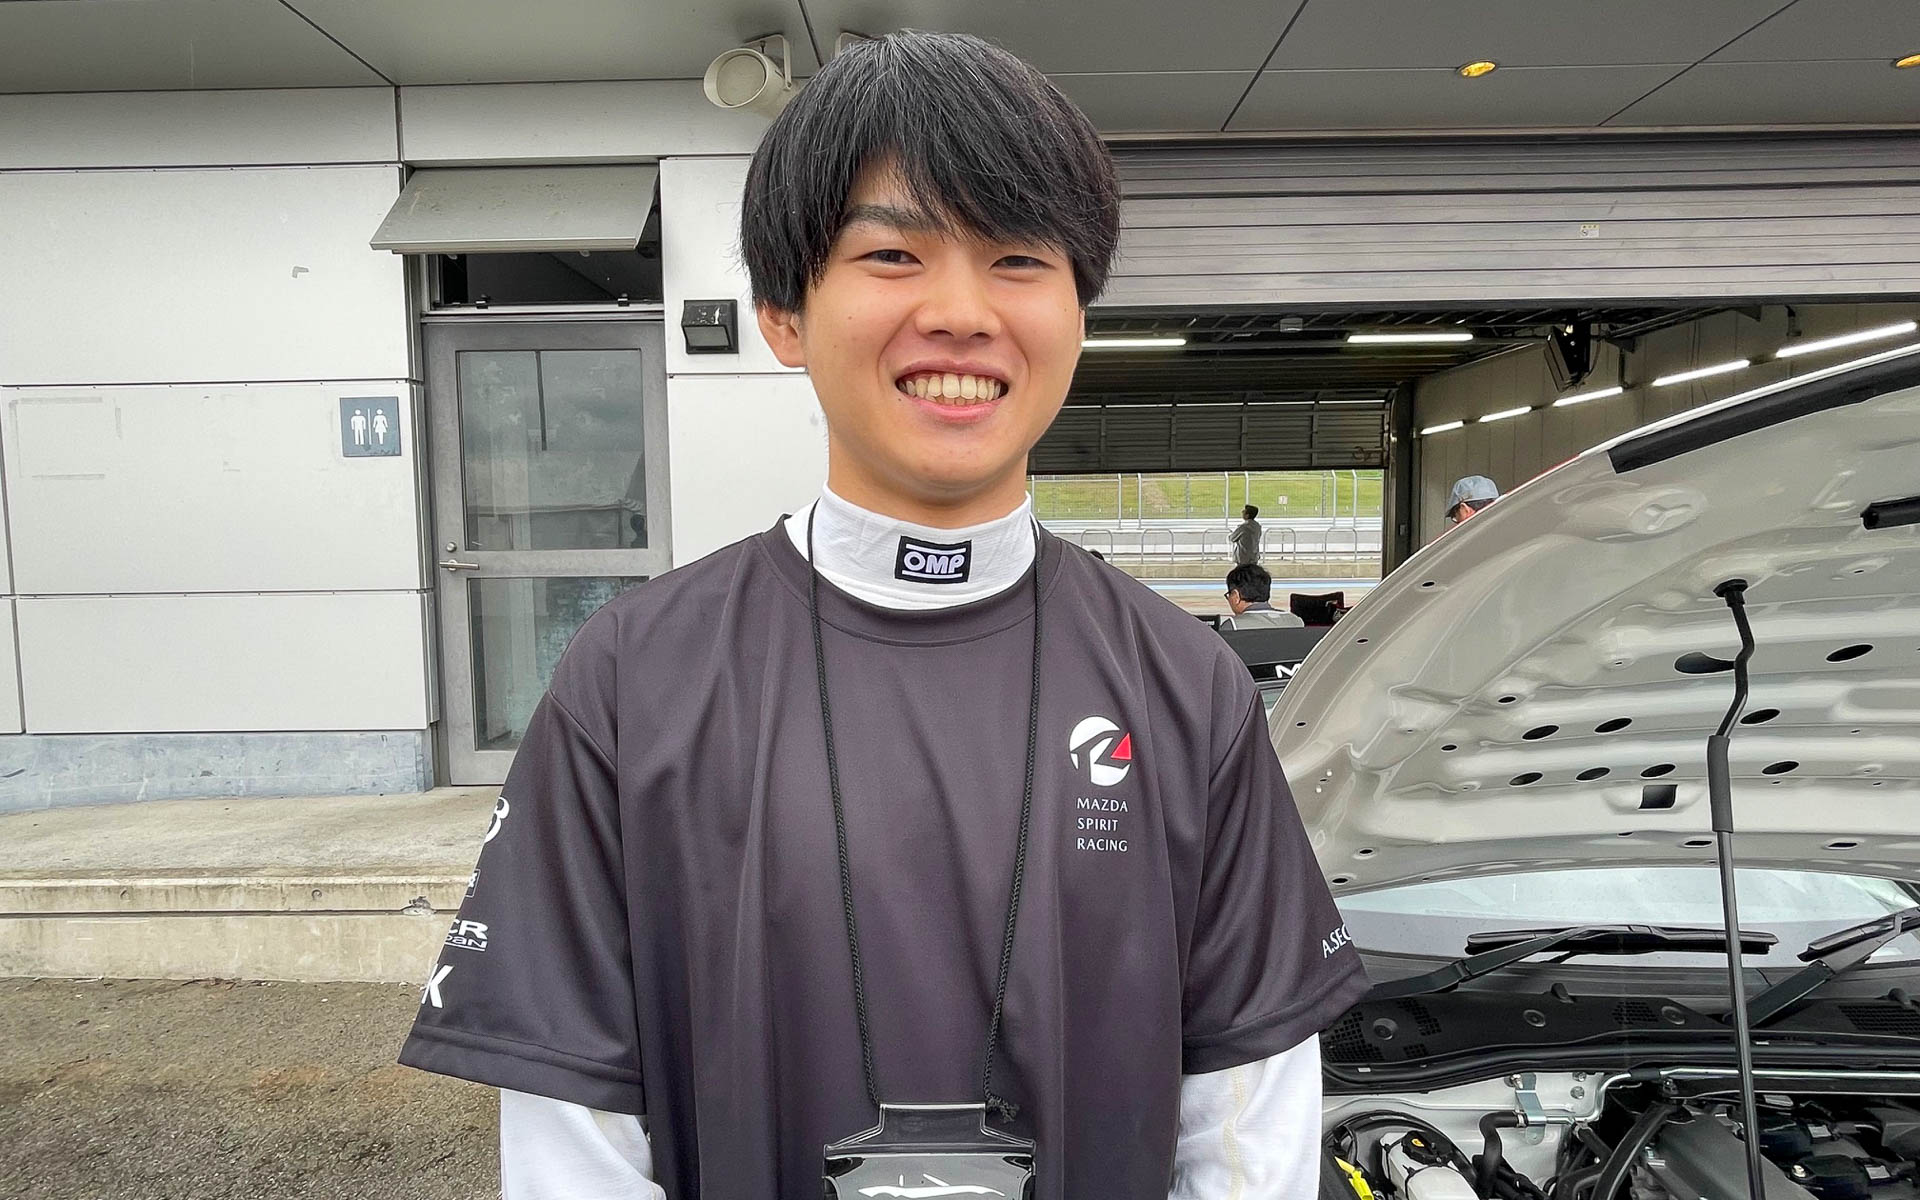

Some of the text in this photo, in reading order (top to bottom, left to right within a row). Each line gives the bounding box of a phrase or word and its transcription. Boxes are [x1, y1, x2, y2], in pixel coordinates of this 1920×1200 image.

[904, 551, 965, 574] OMP
[1077, 797, 1128, 812] MAZDA
[1077, 817, 1118, 831] SPIRIT
[1077, 837, 1128, 852] RACING
